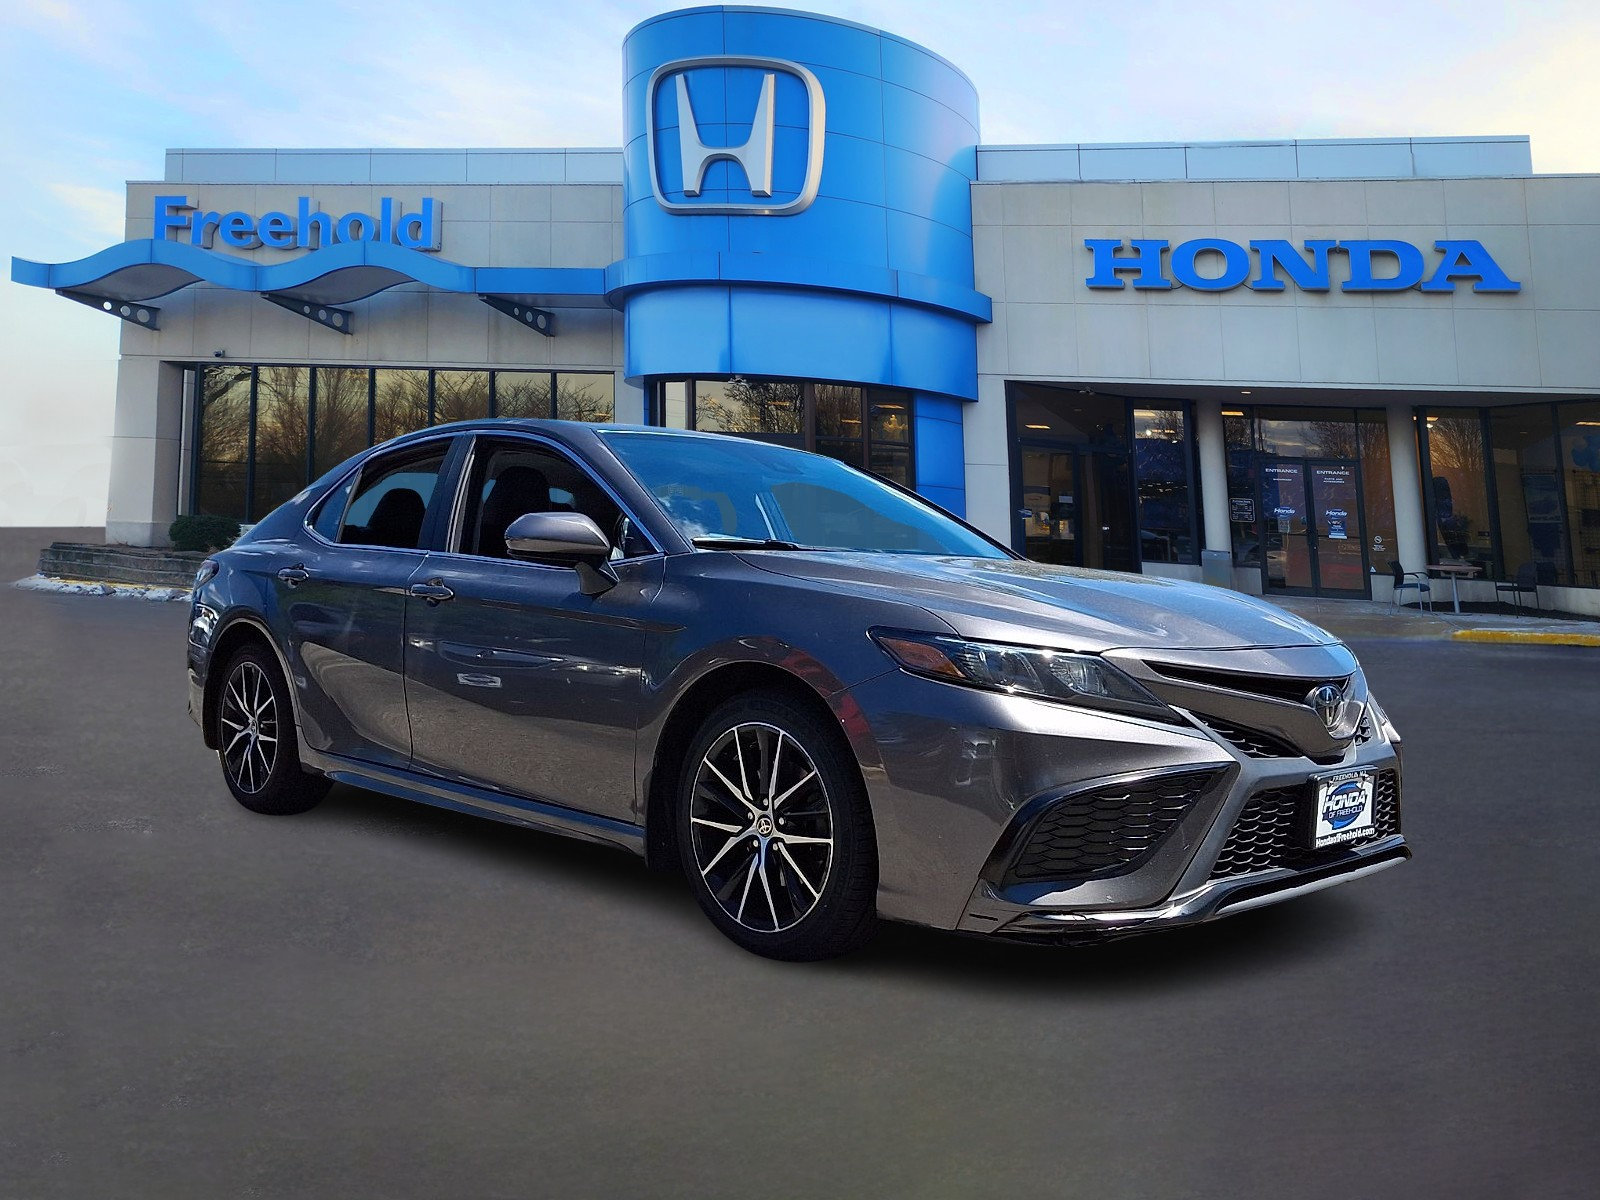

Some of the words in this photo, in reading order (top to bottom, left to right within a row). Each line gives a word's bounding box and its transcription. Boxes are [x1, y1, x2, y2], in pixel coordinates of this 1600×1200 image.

[154, 195, 436, 249] Freehold
[1084, 238, 1521, 293] HONDA
[1323, 790, 1367, 813] HONDA
[1329, 811, 1336, 819] OF
[1336, 804, 1363, 817] FREEHOLD
